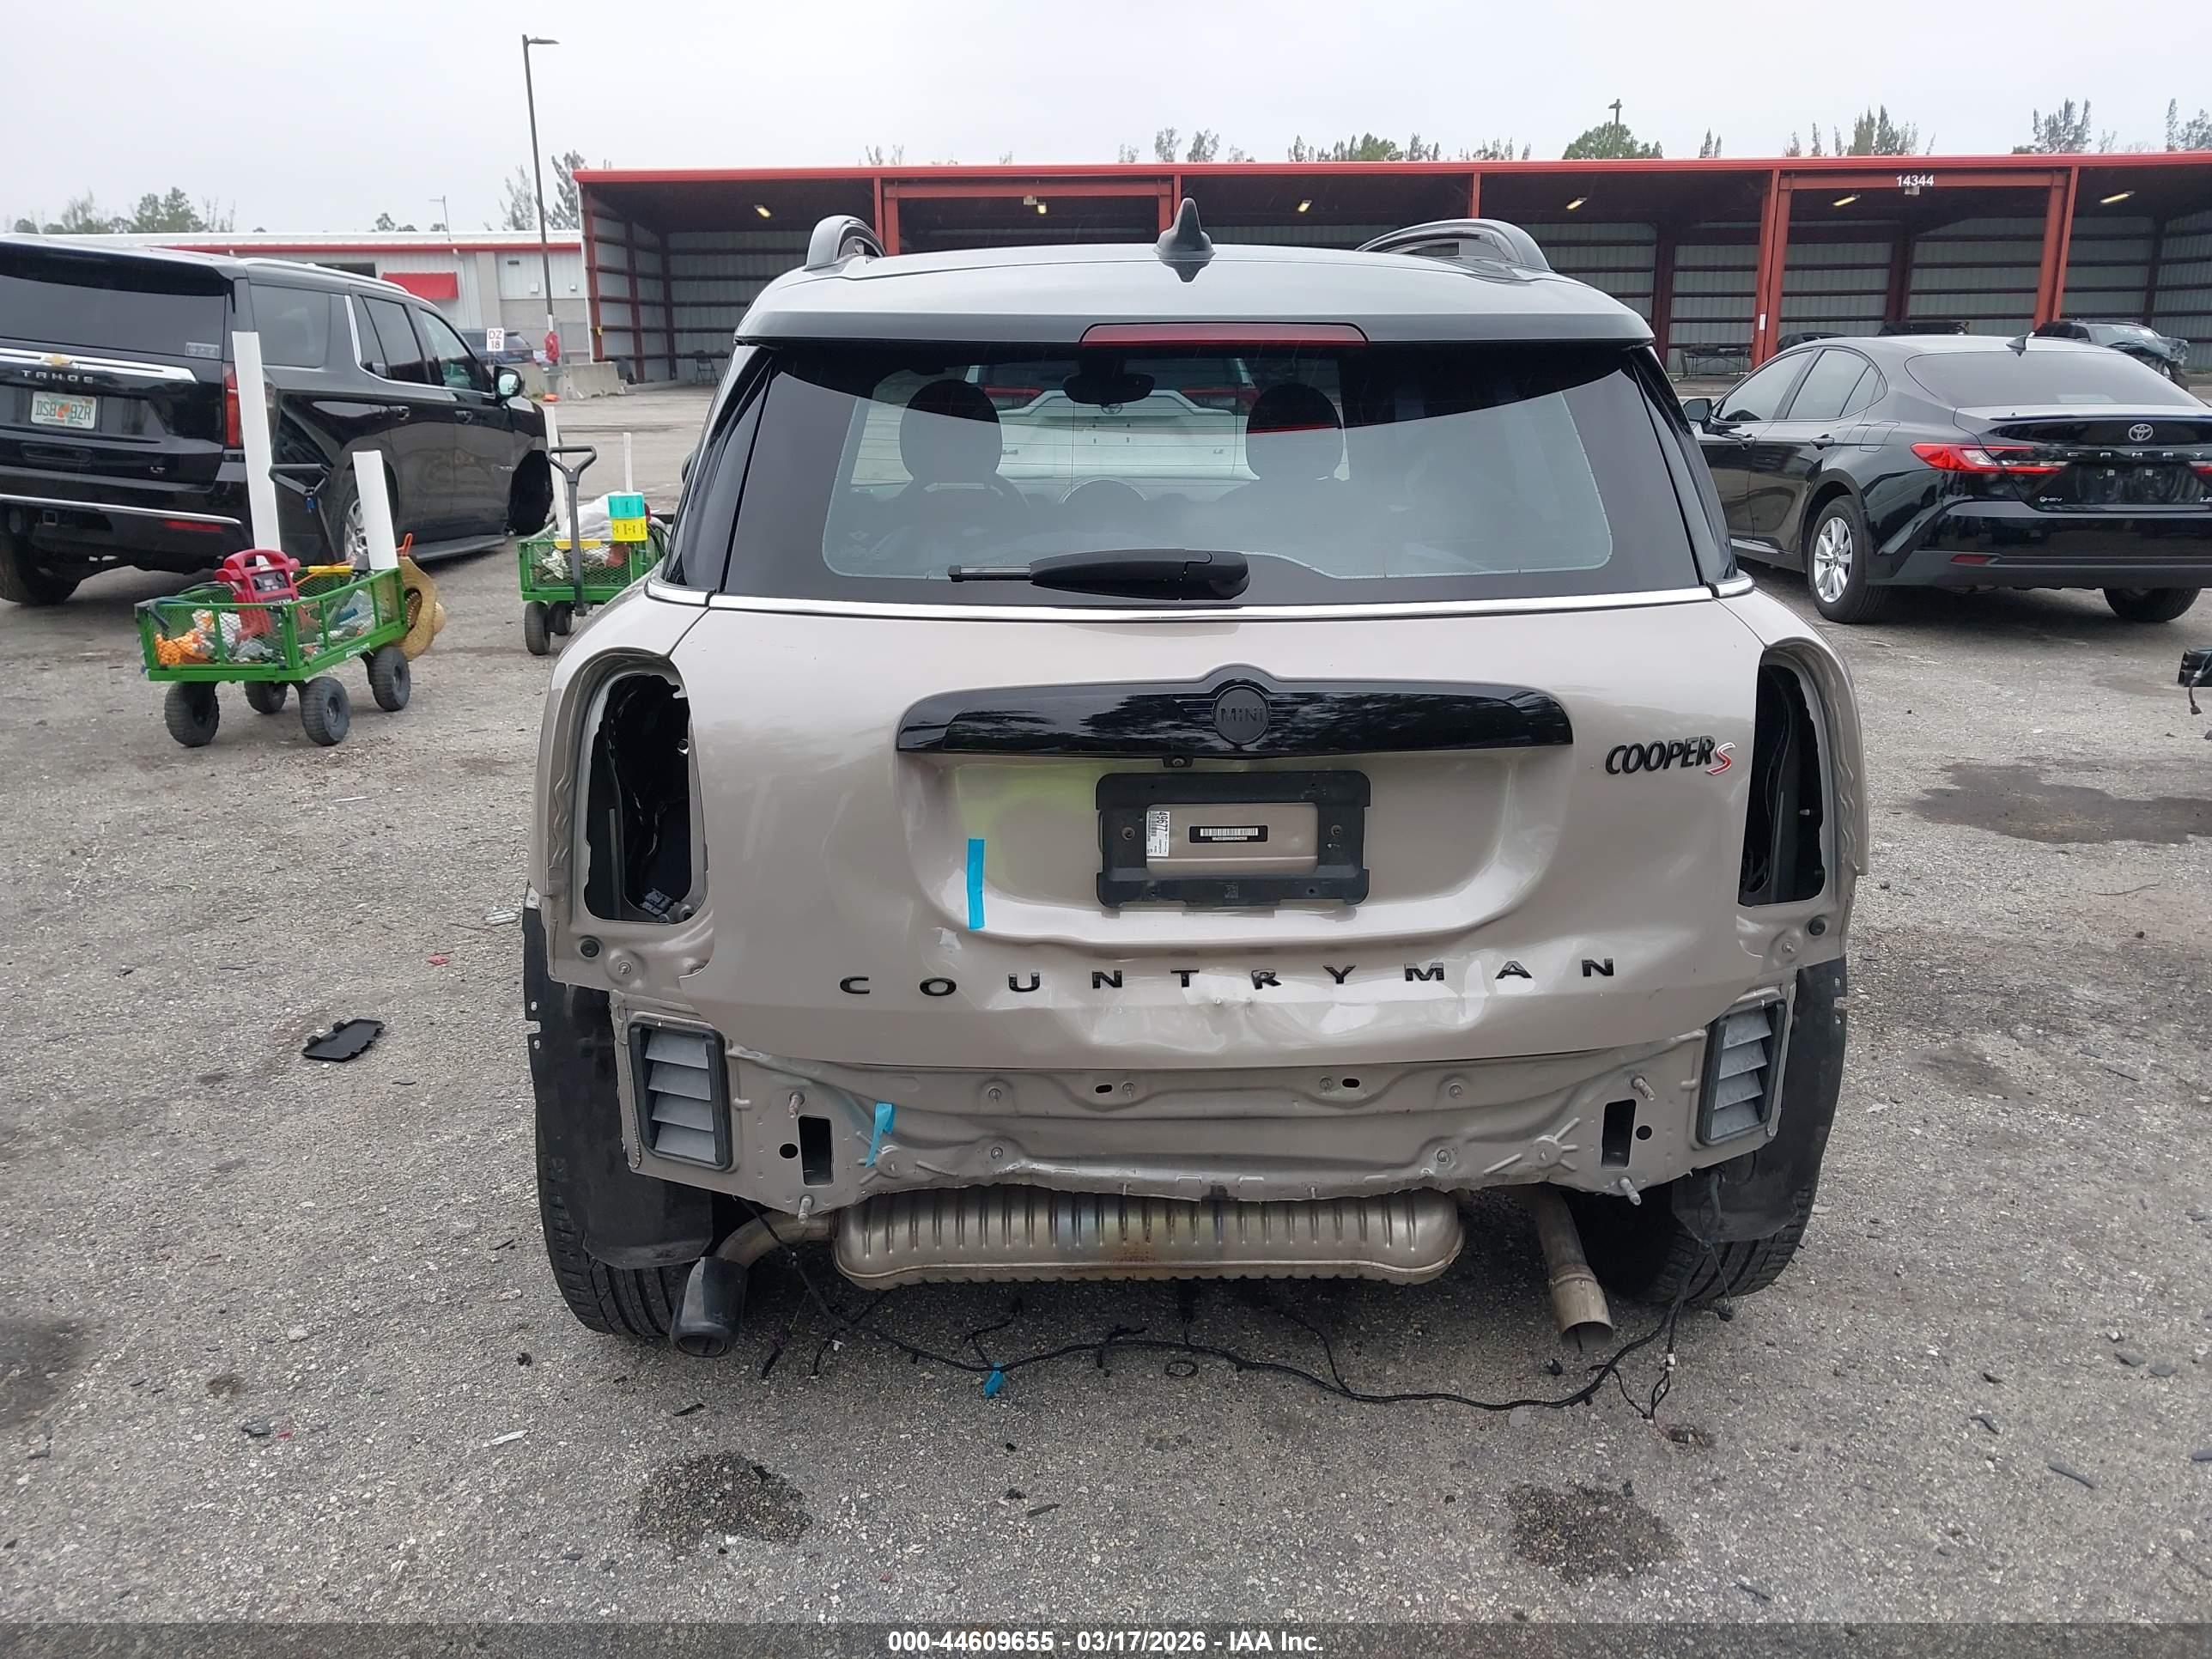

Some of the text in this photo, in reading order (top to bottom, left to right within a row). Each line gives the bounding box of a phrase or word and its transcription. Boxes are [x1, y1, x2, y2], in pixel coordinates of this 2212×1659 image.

[1896, 174, 1935, 186] 14344
[489, 331, 502, 339] DZ
[490, 340, 501, 349] 18
[21, 369, 94, 384] TAHOE
[1220, 707, 1263, 722] MINI
[1605, 735, 1737, 775] COOPER S
[1155, 811, 1169, 832] 49677
[839, 957, 1615, 997] COUNTRYMAN
